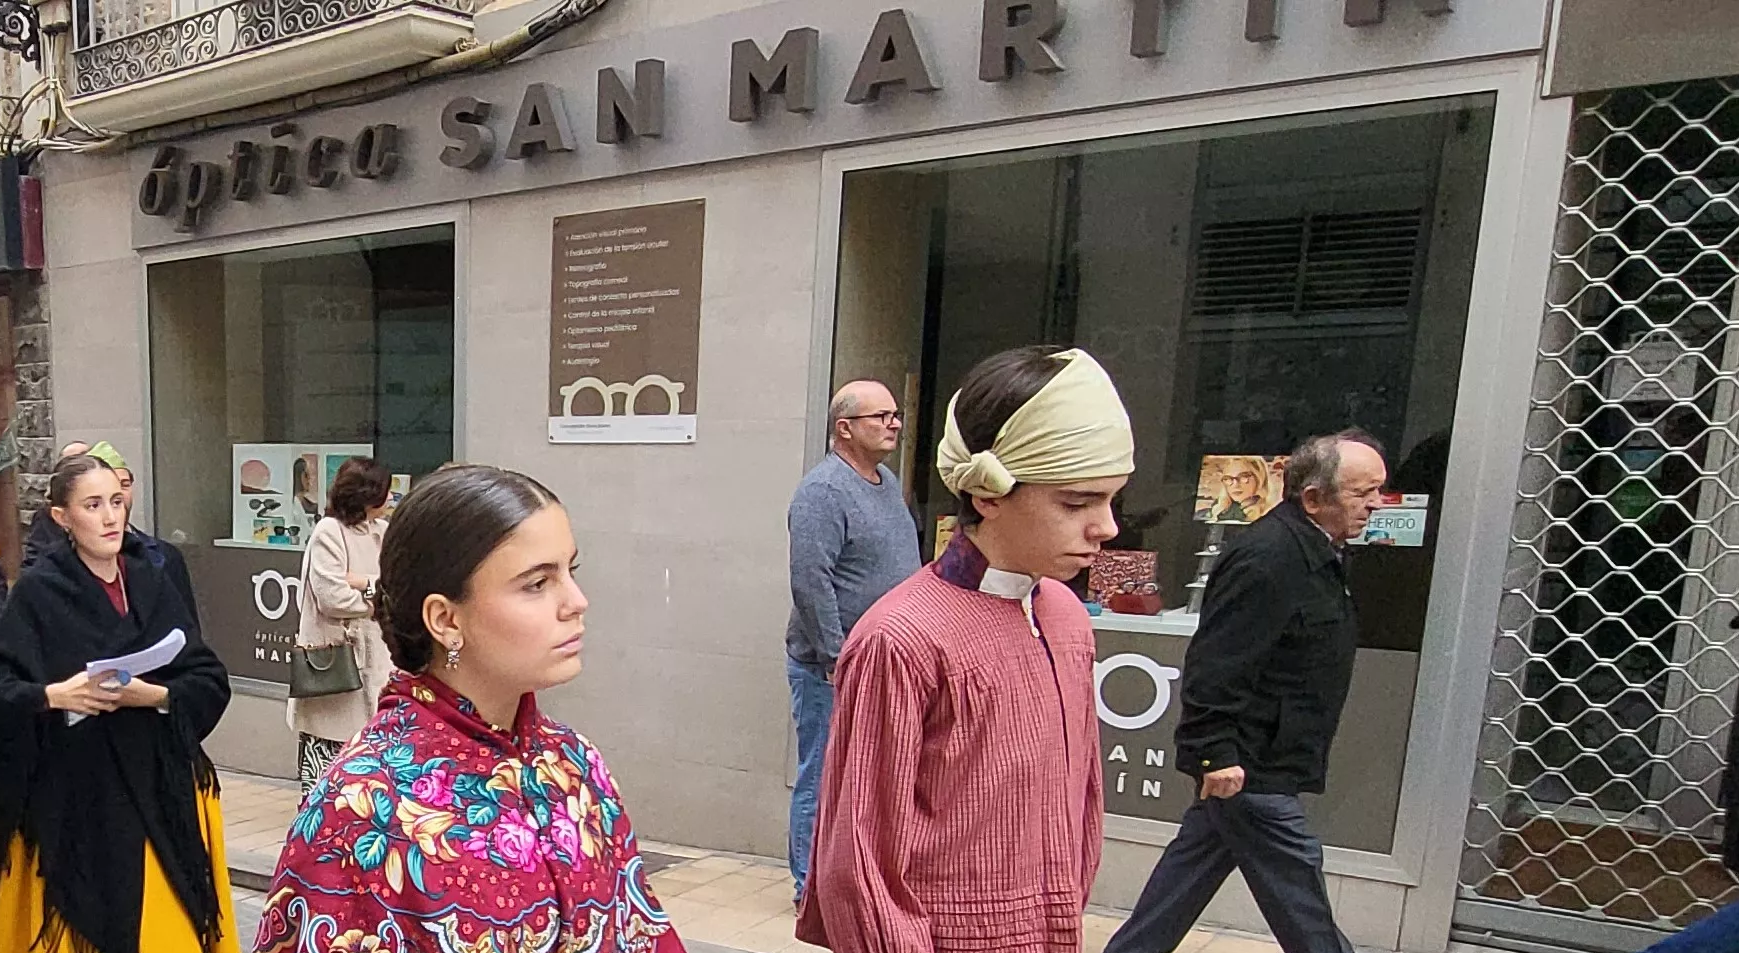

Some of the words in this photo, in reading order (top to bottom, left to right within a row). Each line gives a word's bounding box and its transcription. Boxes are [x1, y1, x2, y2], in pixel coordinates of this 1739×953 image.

[139, 124, 400, 233] óptica
[439, 58, 666, 169] SAN
[730, 0, 1452, 122] MAR
[1368, 517, 1416, 529] HERIDO
[255, 647, 292, 663] MAR
[1107, 744, 1165, 768] AN
[1116, 771, 1162, 798] ÍN
